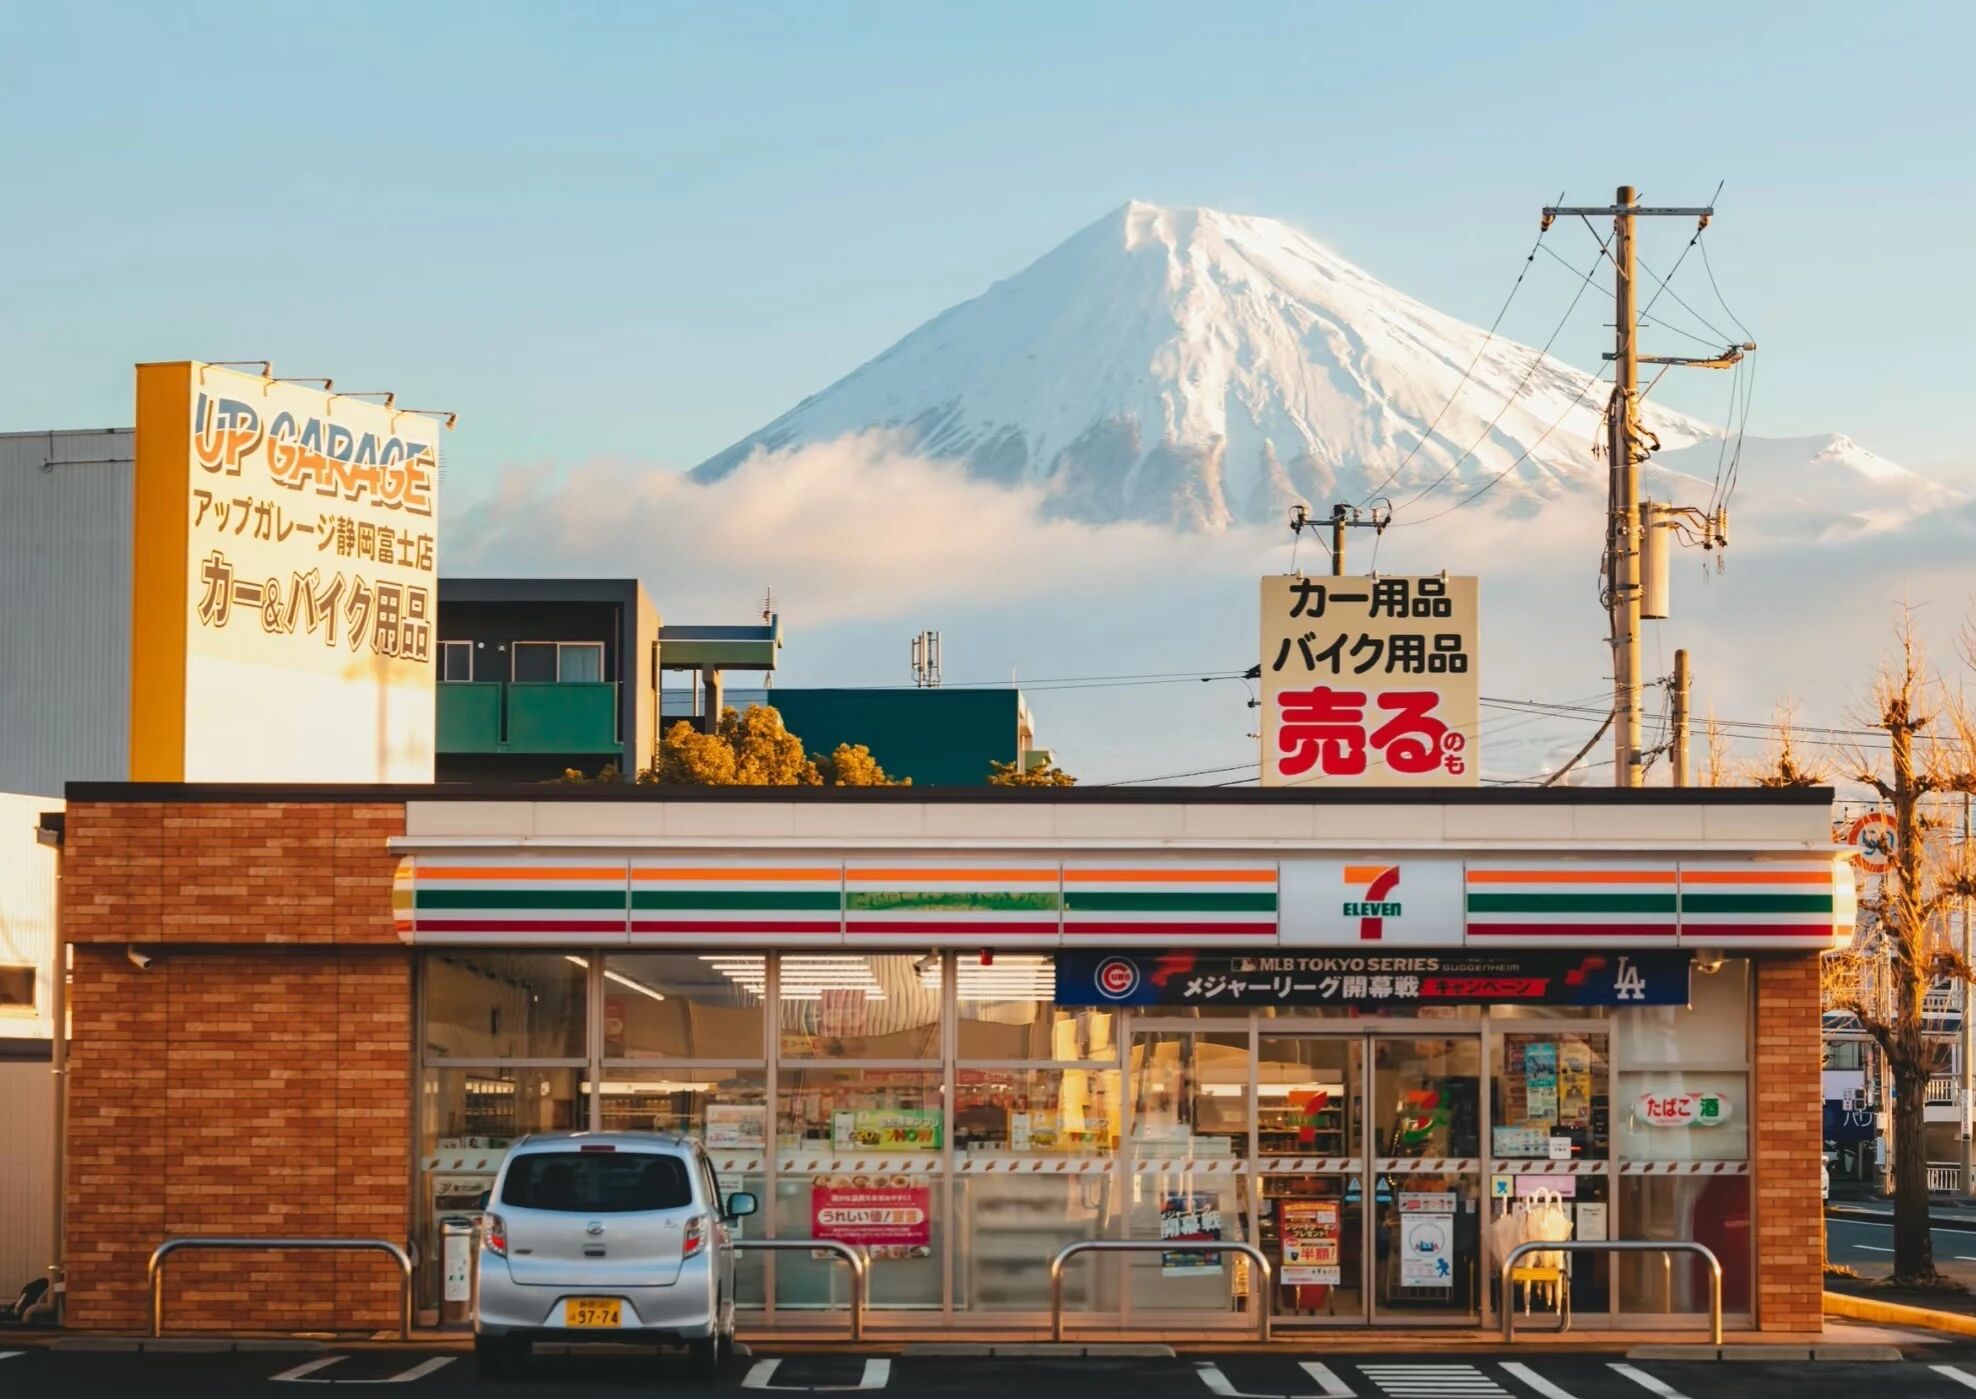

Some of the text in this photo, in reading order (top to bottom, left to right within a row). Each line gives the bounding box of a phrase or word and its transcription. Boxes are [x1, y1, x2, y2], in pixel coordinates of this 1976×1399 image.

[194, 391, 436, 517] UP GARAGE
[193, 488, 434, 572] アップガレージ静岡富士店
[198, 549, 430, 663] カー&バイク用品
[1289, 578, 1452, 618] カー用品
[1272, 631, 1468, 675] バイク用品
[1343, 866, 1400, 940] 7
[1260, 957, 1295, 972] MLB
[1297, 957, 1365, 972] TOKYO
[1367, 957, 1440, 972] SERIES
[1613, 956, 1647, 1000] LA
[1183, 975, 1532, 999] メジャーリーグ開幕戦 キャンペーン
[1647, 1097, 1720, 1118] たばこ 酒
